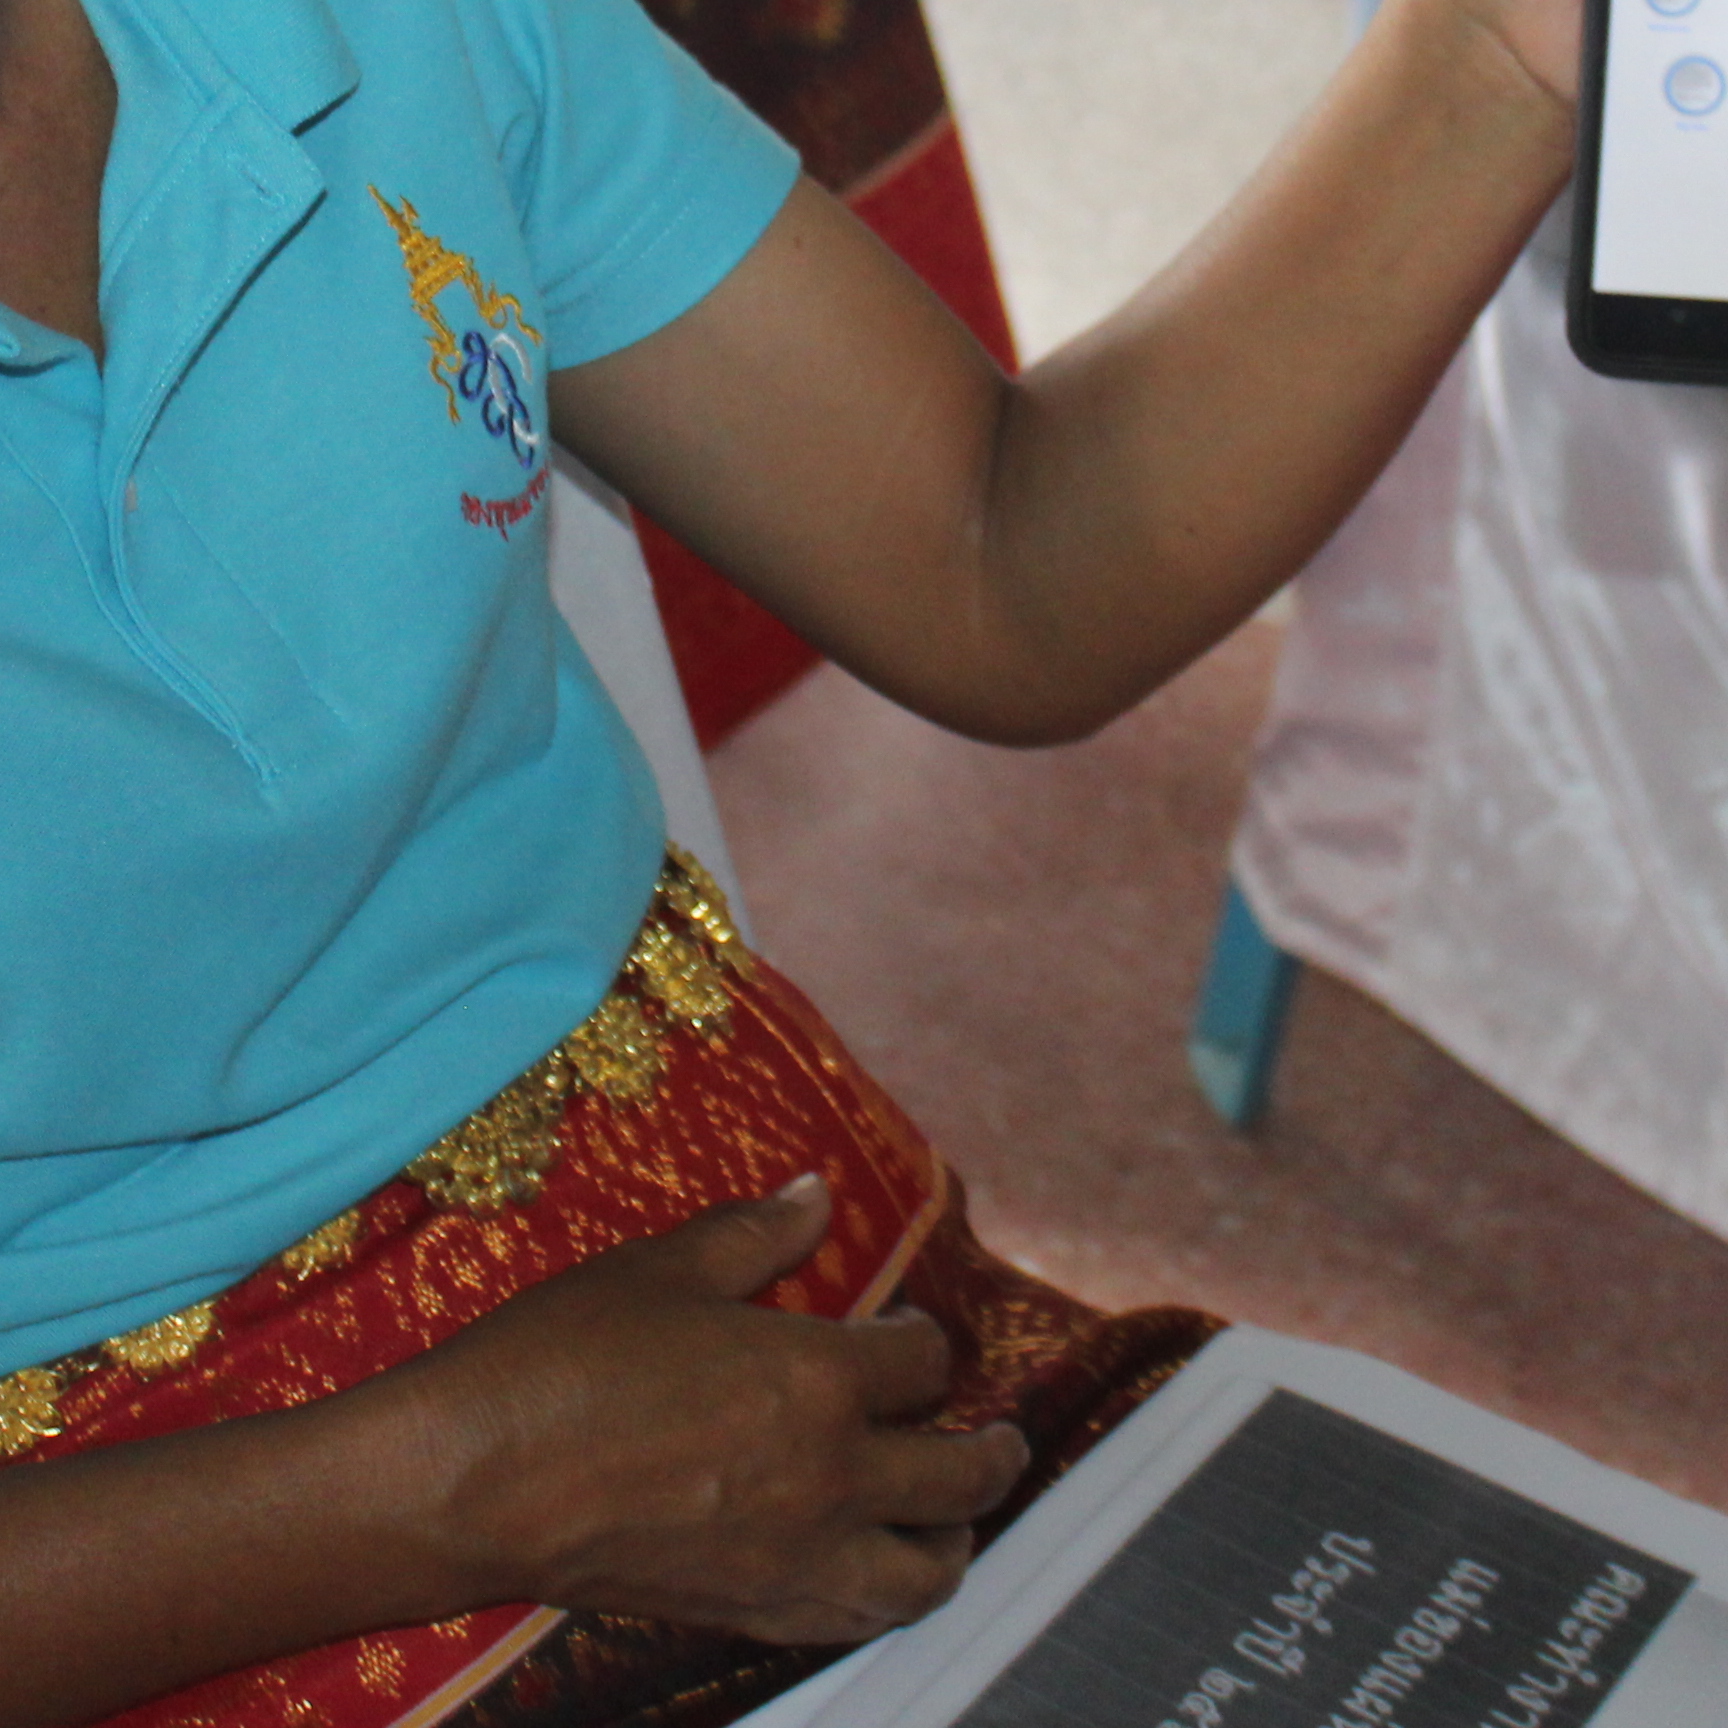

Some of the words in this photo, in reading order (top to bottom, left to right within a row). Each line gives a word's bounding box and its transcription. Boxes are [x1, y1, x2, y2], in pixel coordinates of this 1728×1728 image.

[1233, 1531, 1375, 1676] ประจำปี
[1478, 1562, 1647, 1728] คณะทำงา
